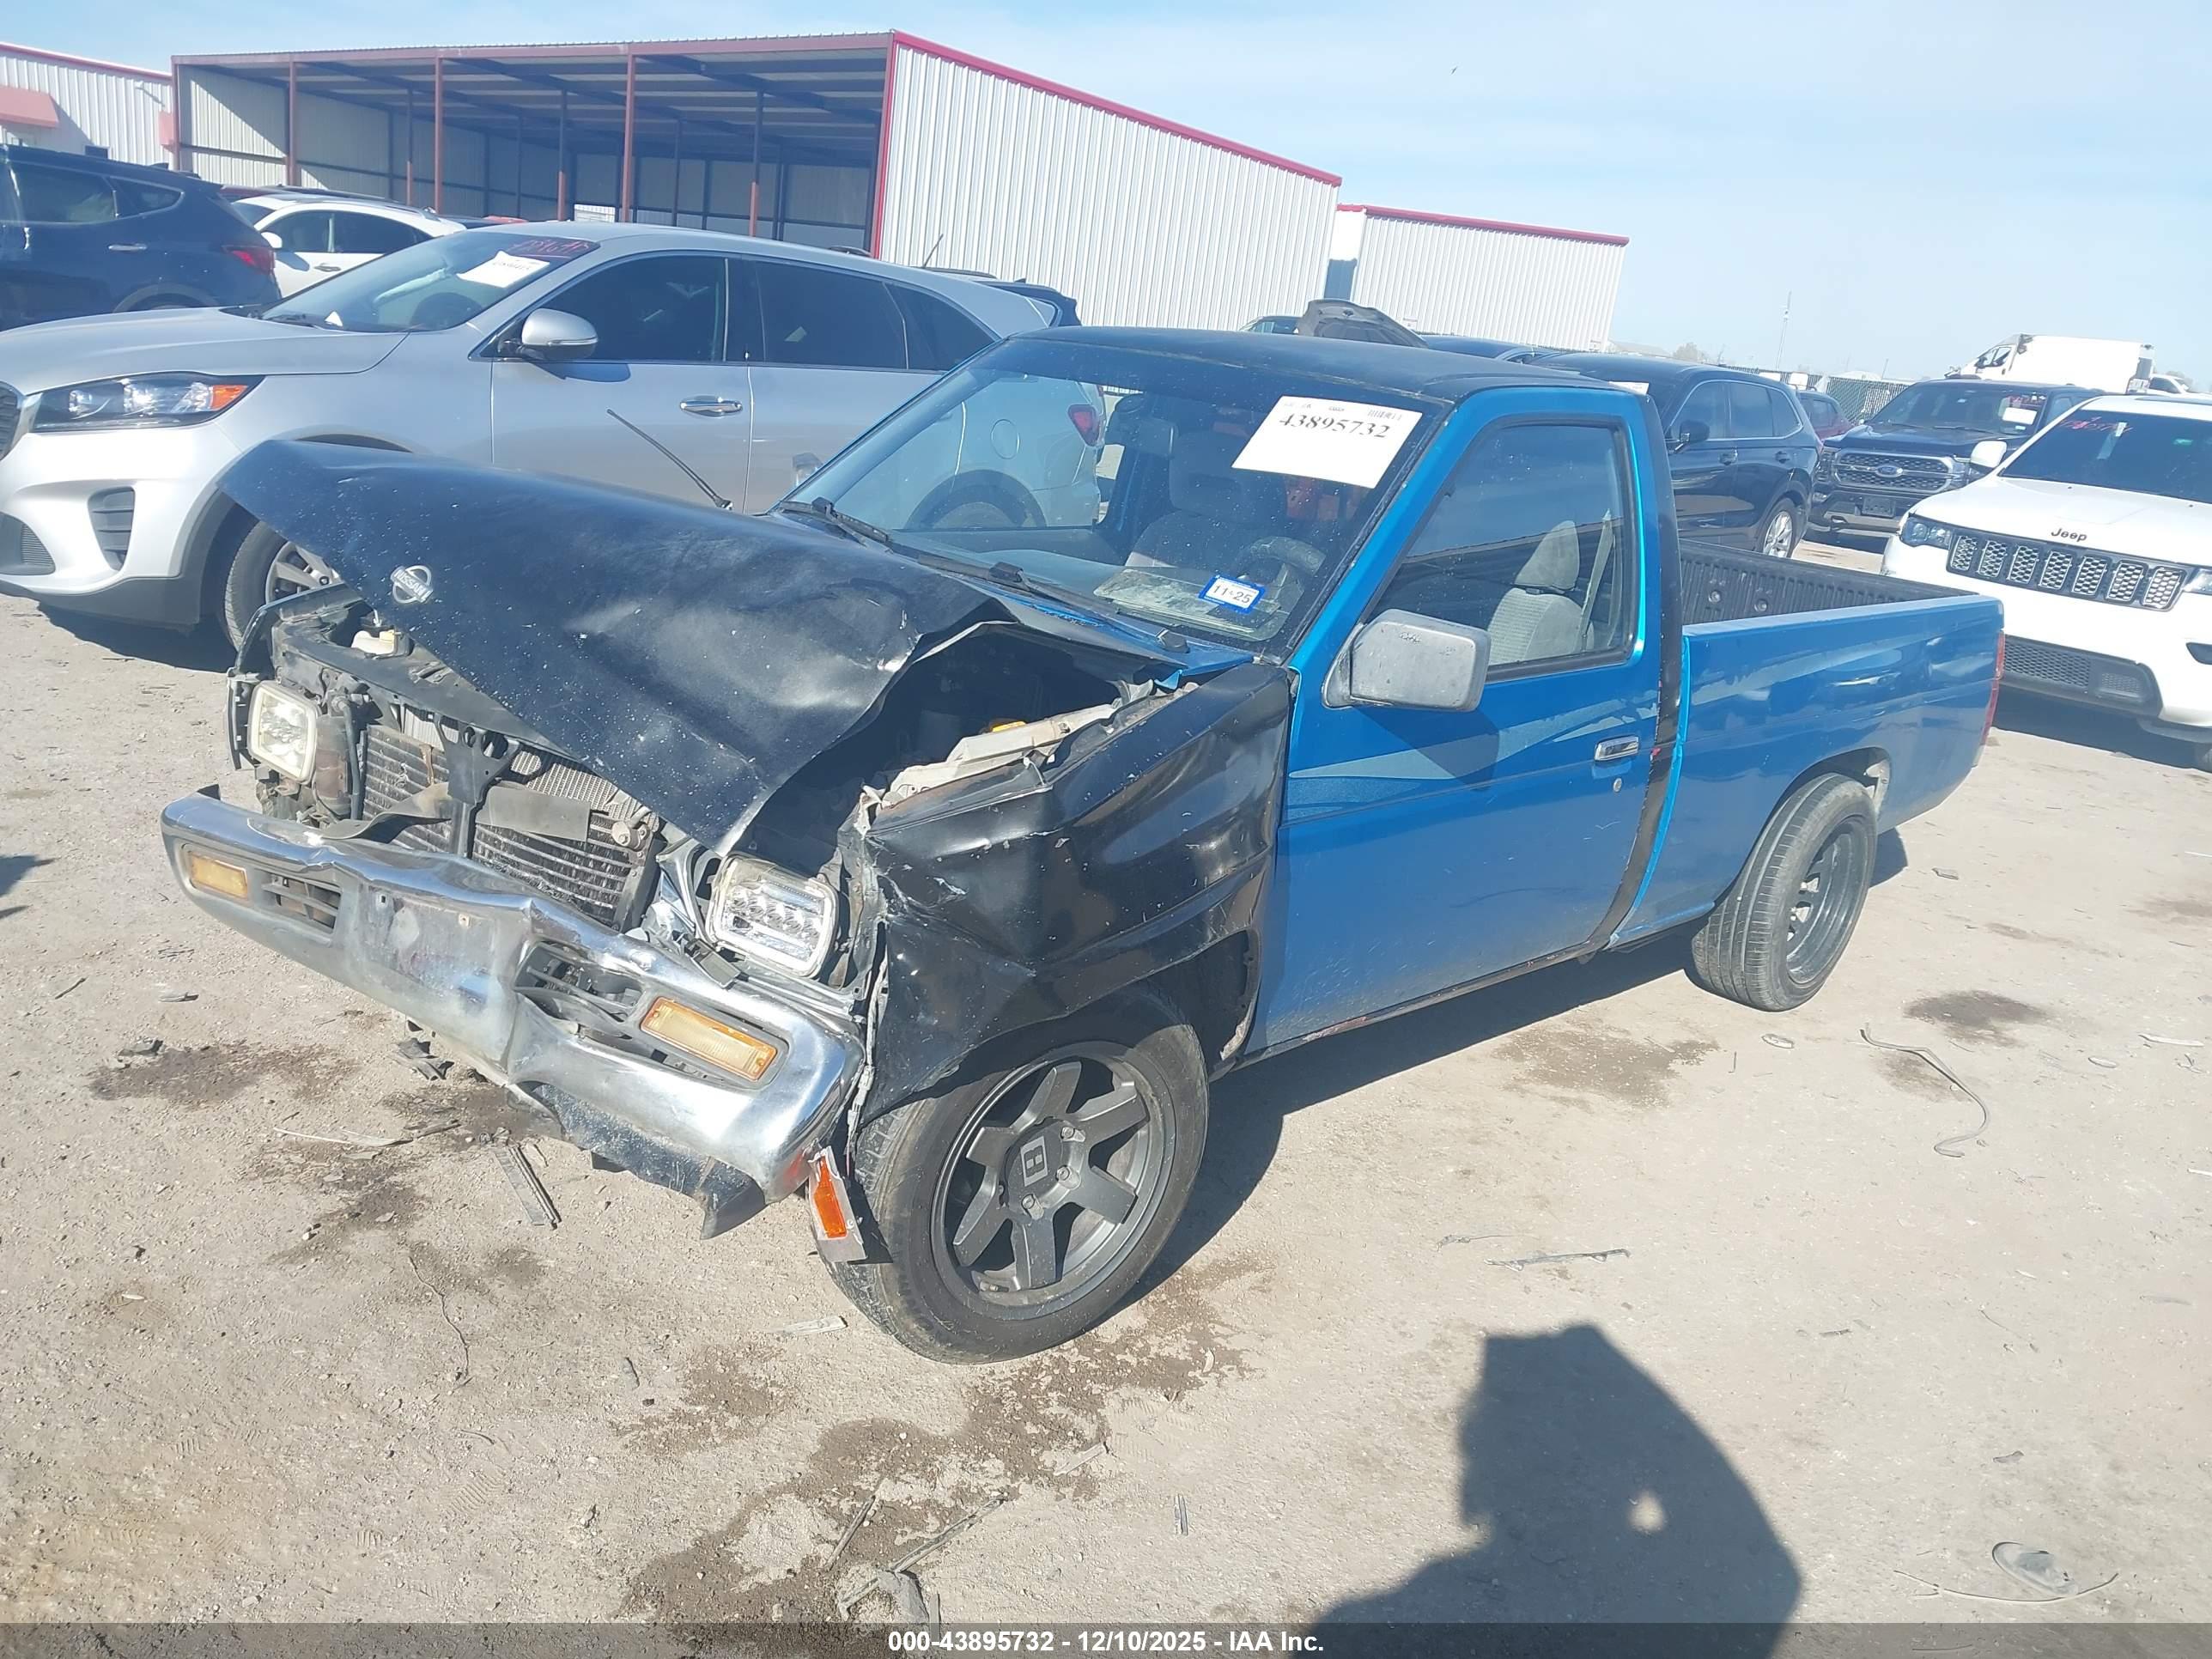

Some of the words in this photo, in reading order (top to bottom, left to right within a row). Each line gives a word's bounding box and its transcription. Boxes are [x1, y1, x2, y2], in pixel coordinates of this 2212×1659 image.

[1279, 413, 1390, 438] 43895732
[2051, 528, 2087, 542] Jeep
[393, 569, 427, 599] NISSAN
[1233, 591, 1253, 604] 25
